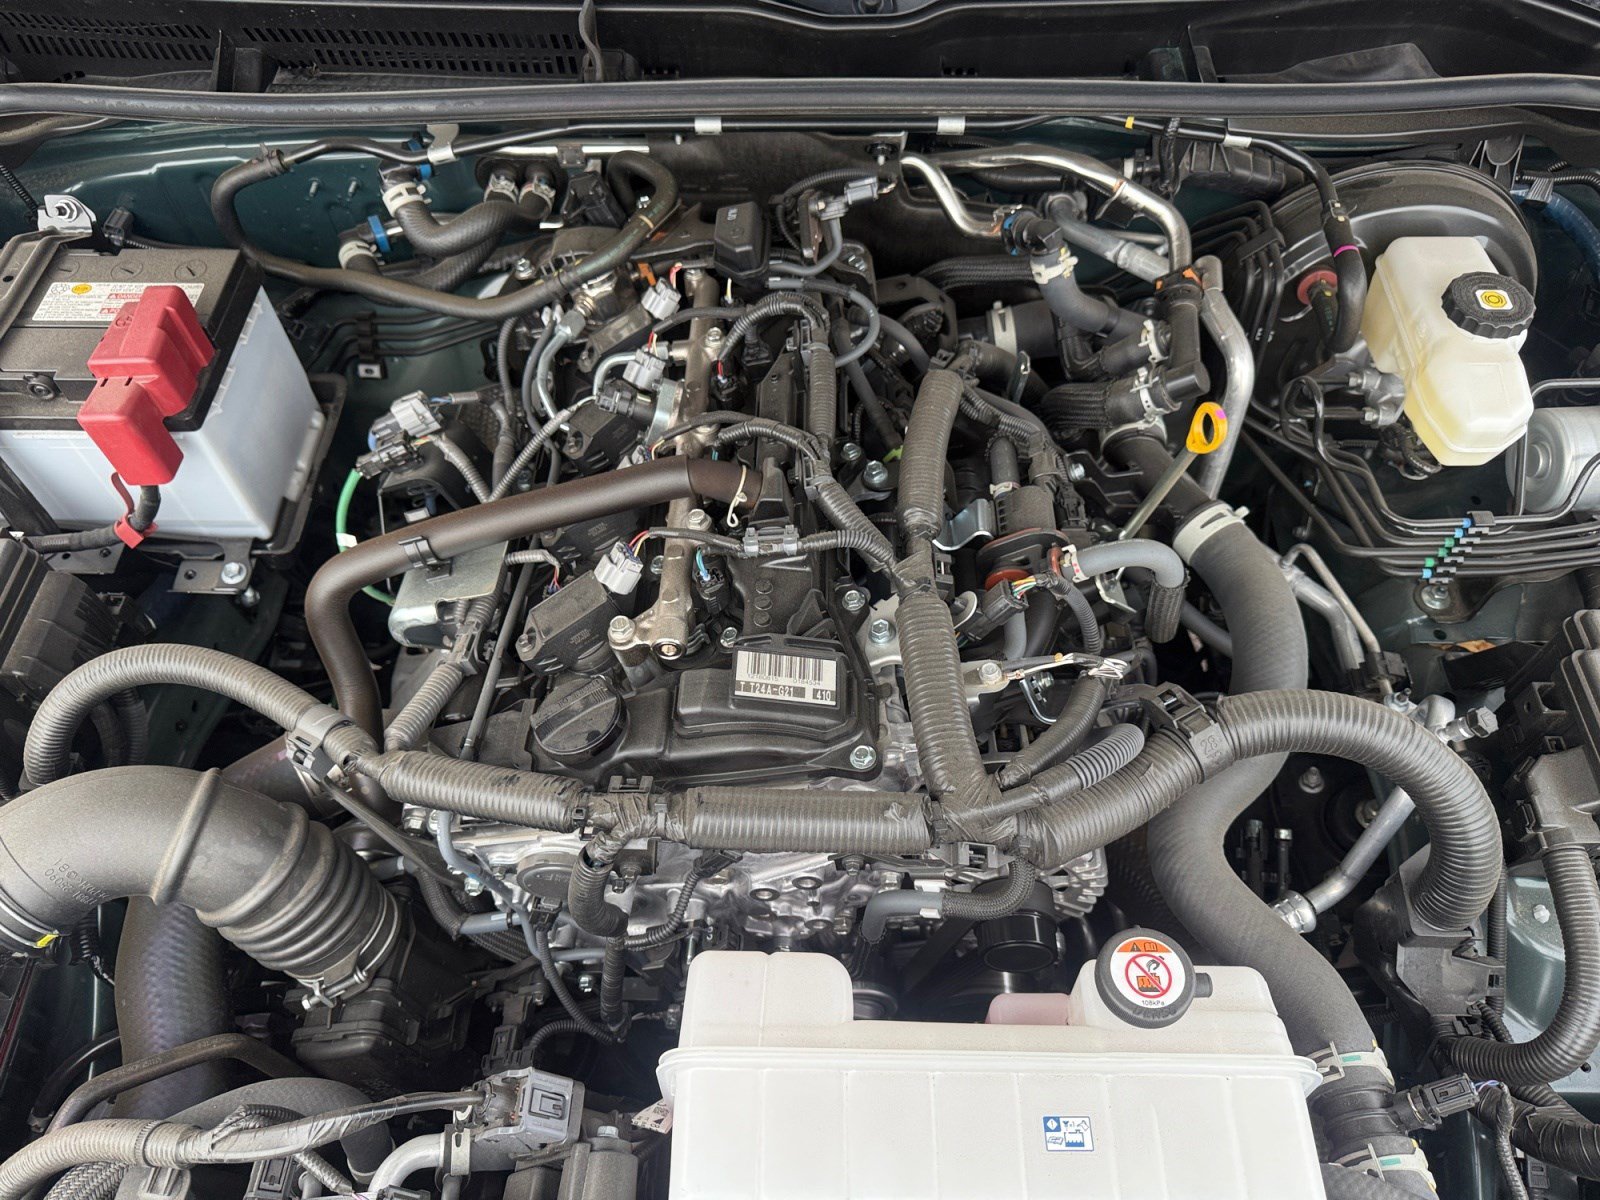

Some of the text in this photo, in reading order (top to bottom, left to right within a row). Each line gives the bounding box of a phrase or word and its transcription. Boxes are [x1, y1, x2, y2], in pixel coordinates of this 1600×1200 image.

[740, 682, 831, 701] T T24A-G21 410
